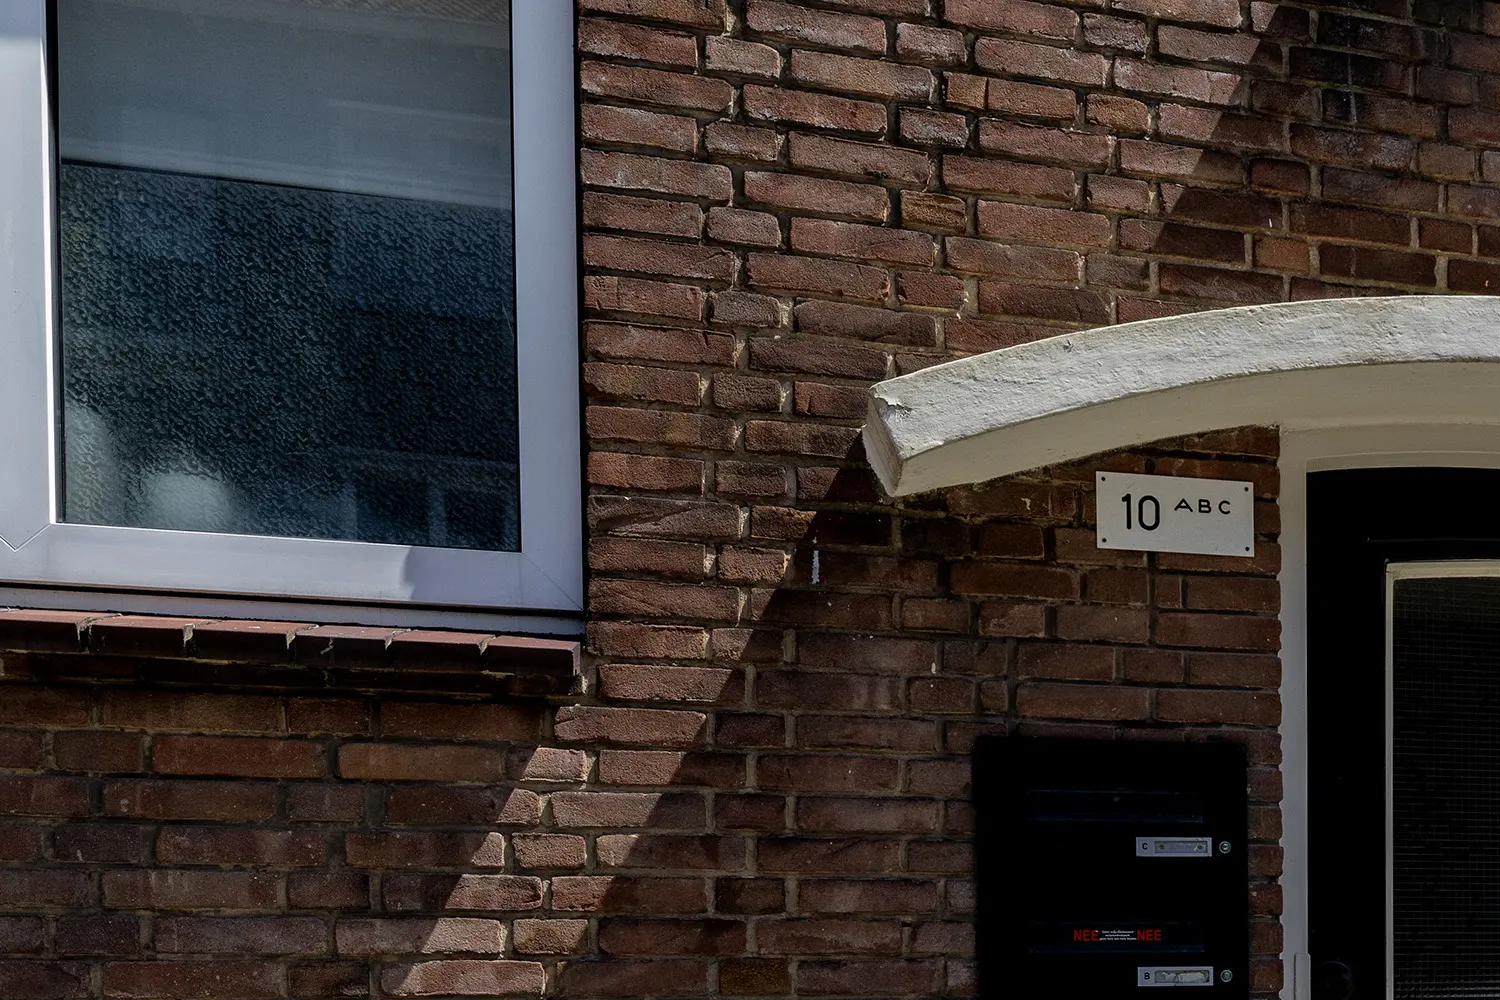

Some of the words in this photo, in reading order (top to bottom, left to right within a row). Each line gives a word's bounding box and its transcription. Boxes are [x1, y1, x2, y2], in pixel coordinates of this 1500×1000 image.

[1121, 493, 1160, 531] 10
[1142, 842, 1148, 850] C
[1073, 929, 1100, 942] NEE
[1136, 929, 1162, 941] NEE
[1144, 972, 1151, 980] B
